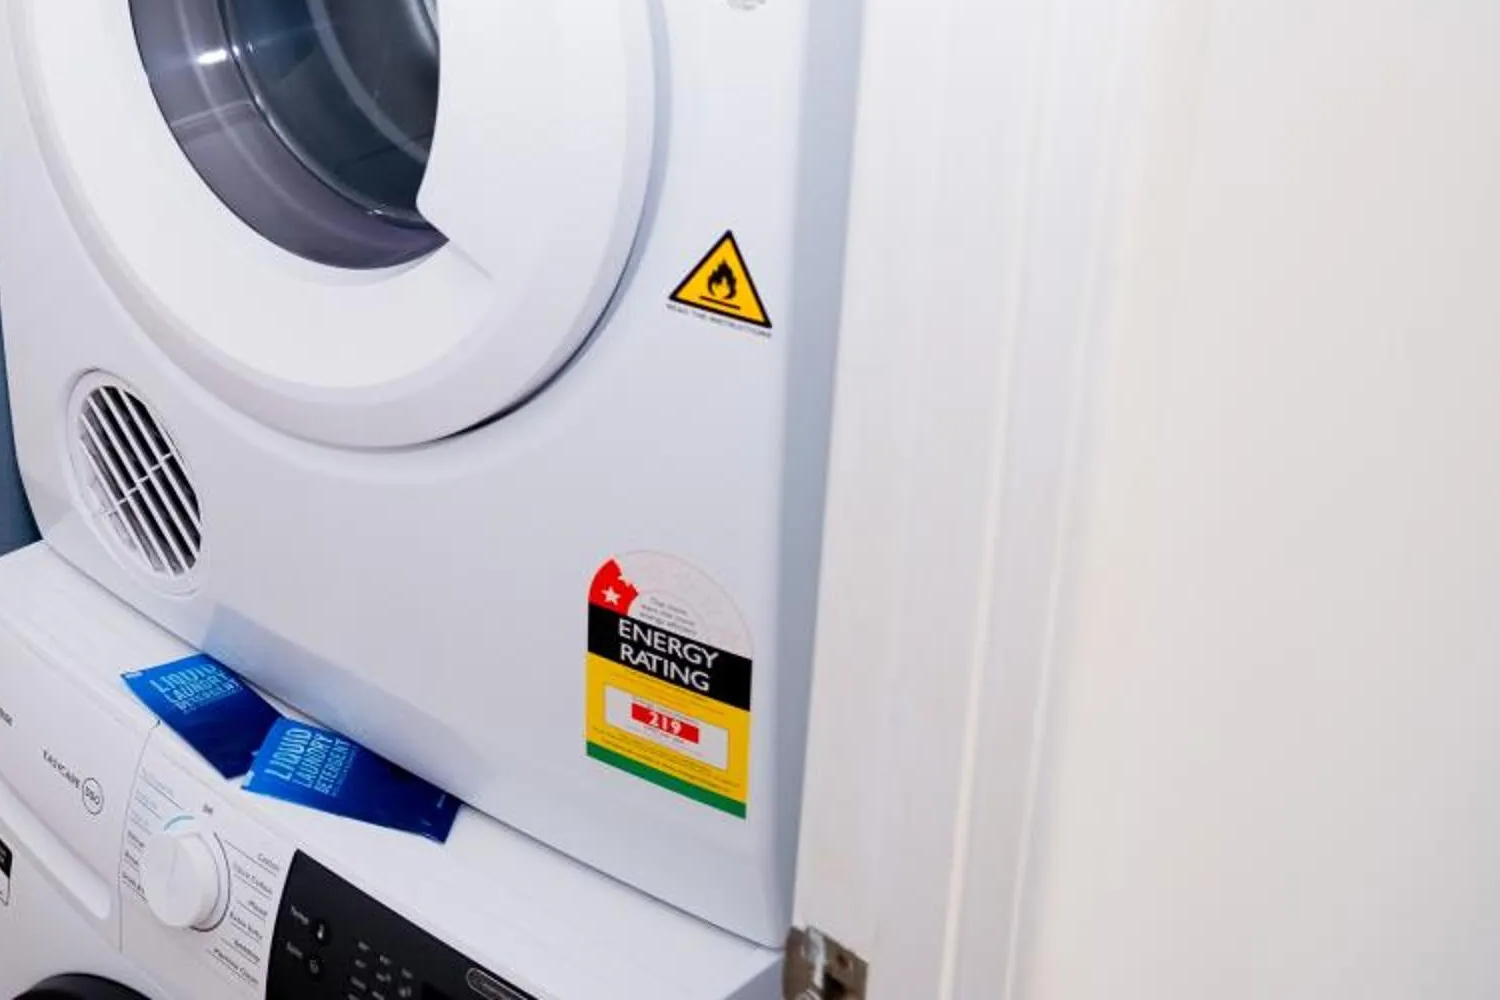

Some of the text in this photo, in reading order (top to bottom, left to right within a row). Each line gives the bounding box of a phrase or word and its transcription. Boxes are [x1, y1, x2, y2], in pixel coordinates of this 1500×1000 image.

[618, 618, 719, 668] ENERGY
[149, 663, 217, 693] LIQUID
[164, 671, 231, 704] LAUNDRY
[620, 644, 710, 691] RATING
[649, 711, 682, 735] 219
[264, 727, 312, 781] LIQUID
[292, 732, 335, 789] LAUNDRY
[314, 737, 354, 795] DETERGENT
